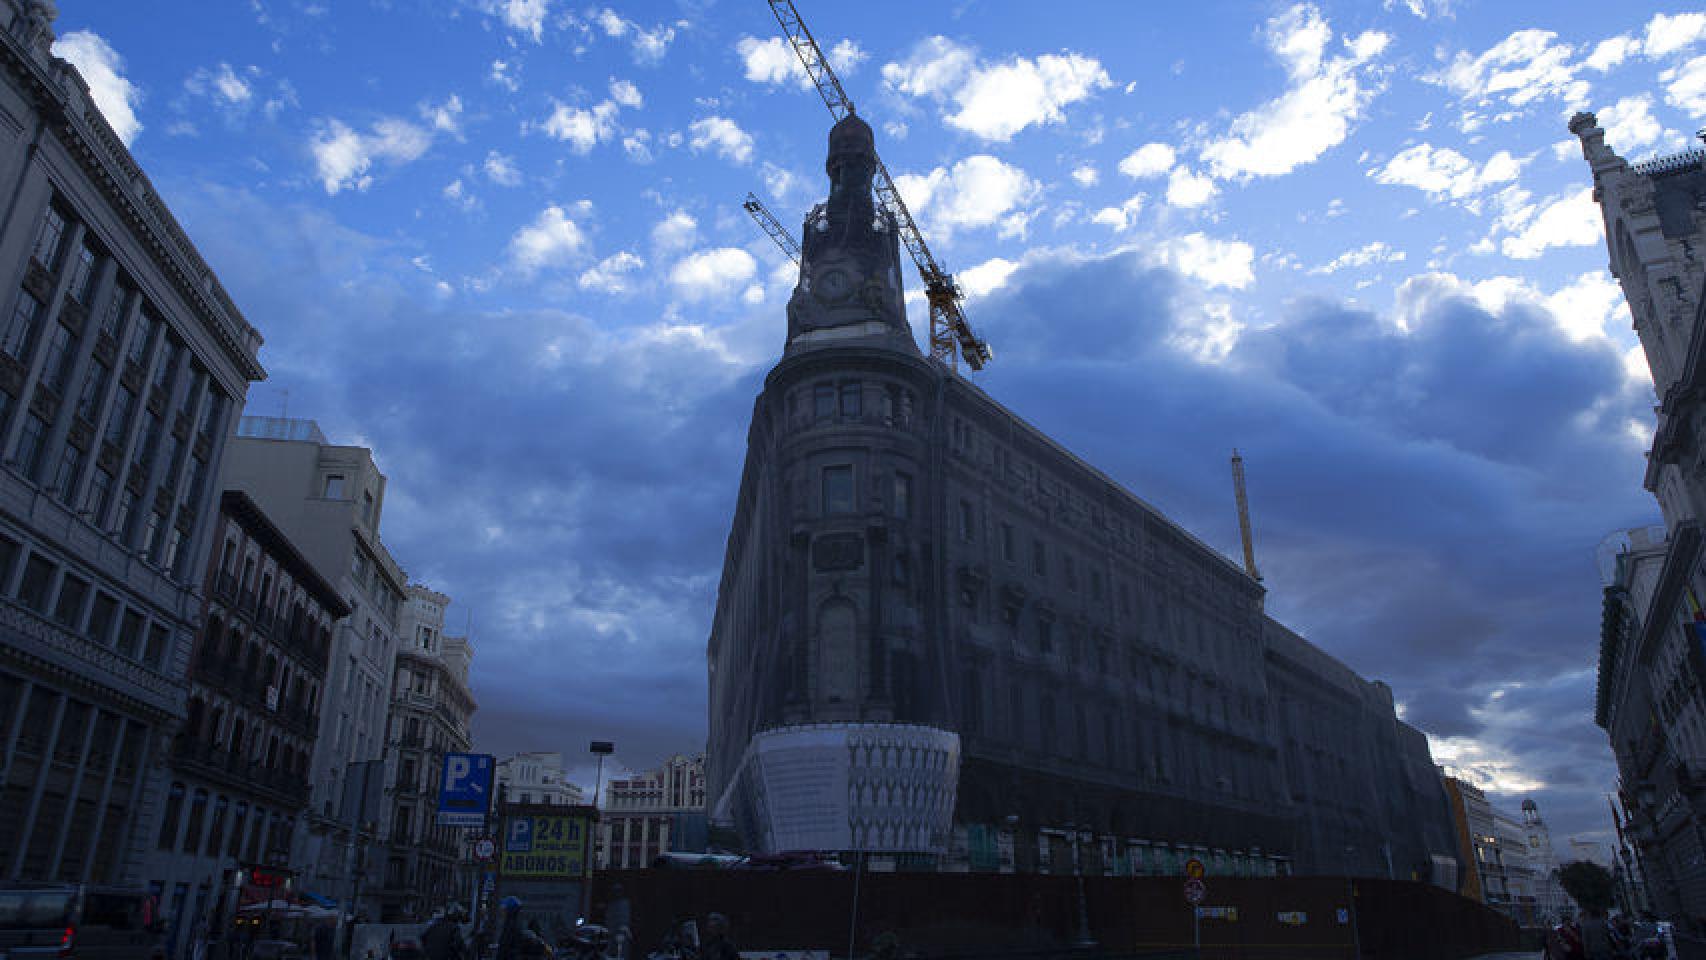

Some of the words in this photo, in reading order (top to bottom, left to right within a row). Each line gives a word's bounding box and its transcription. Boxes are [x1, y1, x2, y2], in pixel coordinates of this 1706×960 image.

[446, 756, 470, 792] P
[511, 819, 529, 840] P
[536, 819, 562, 841] 24
[567, 818, 579, 841] h
[505, 855, 567, 872] ABONOS
